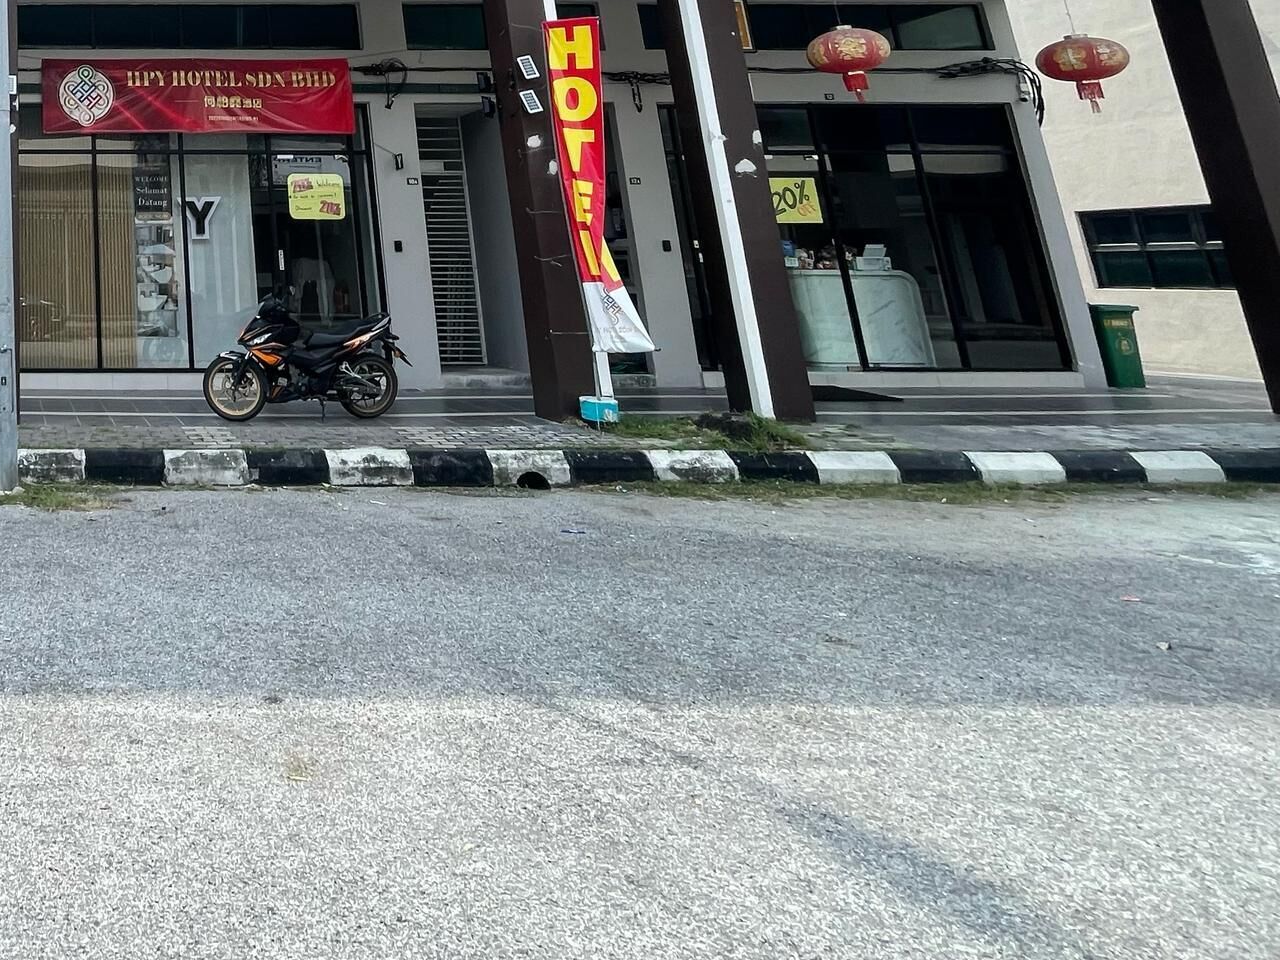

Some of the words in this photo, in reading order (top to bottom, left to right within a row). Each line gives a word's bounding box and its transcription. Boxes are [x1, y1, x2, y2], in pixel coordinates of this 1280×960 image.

[127, 70, 165, 87] HPY
[171, 71, 242, 87] HOTEL
[244, 71, 286, 88] SDN
[291, 71, 335, 87] BHD
[135, 186, 167, 194] Selamat
[771, 180, 810, 215] 20%
[138, 196, 168, 207] Datang
[183, 199, 218, 236] Y
